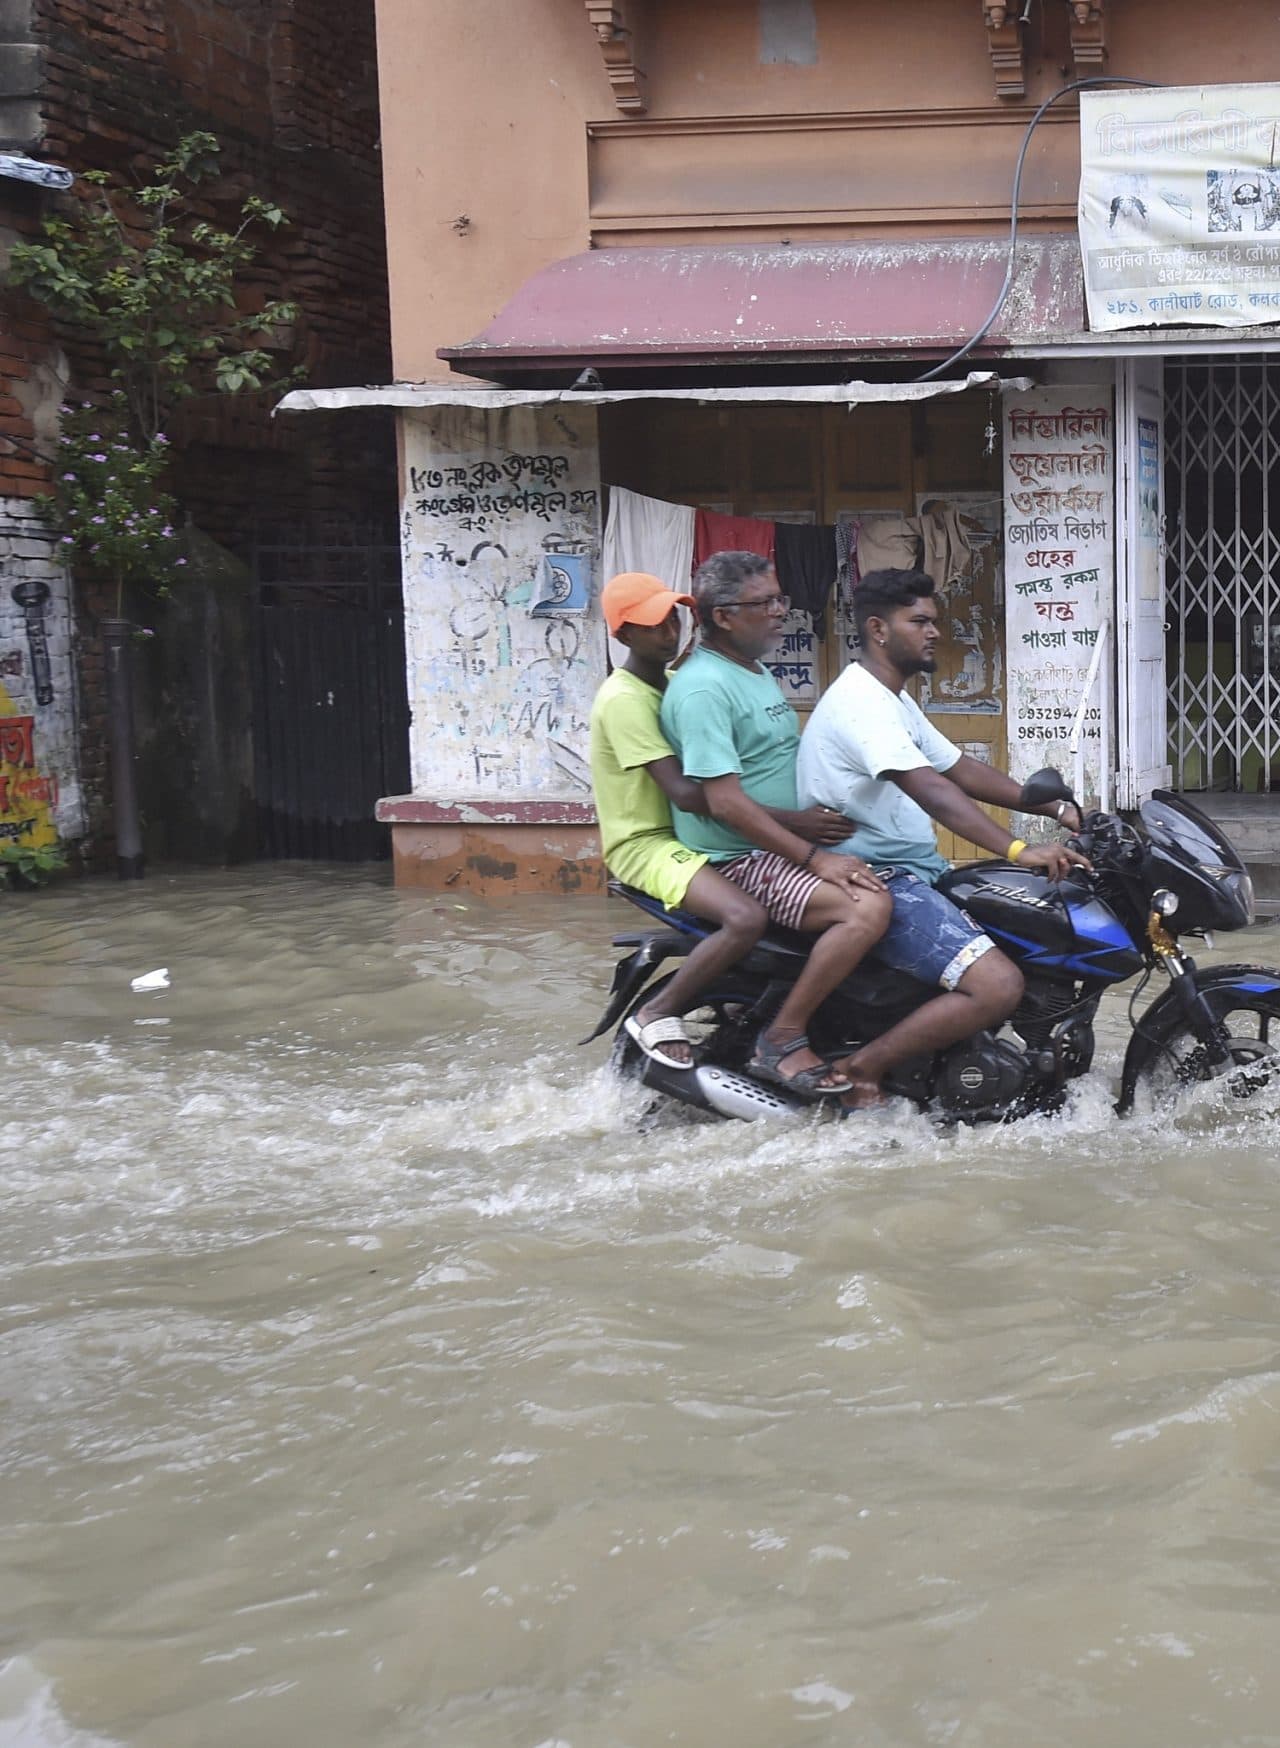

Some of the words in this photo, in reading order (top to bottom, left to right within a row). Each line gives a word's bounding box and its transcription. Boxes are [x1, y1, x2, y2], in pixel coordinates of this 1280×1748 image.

[1009, 517, 1059, 545] জ্যোতিষ
[1064, 517, 1107, 540] বিভাগ
[1025, 549, 1077, 568] গ্রহের
[1015, 577, 1053, 597] সমস্ত
[1060, 568, 1100, 589] রকম
[1022, 629, 1066, 648] পাওয়া
[972, 882, 1055, 909] Pulsar
